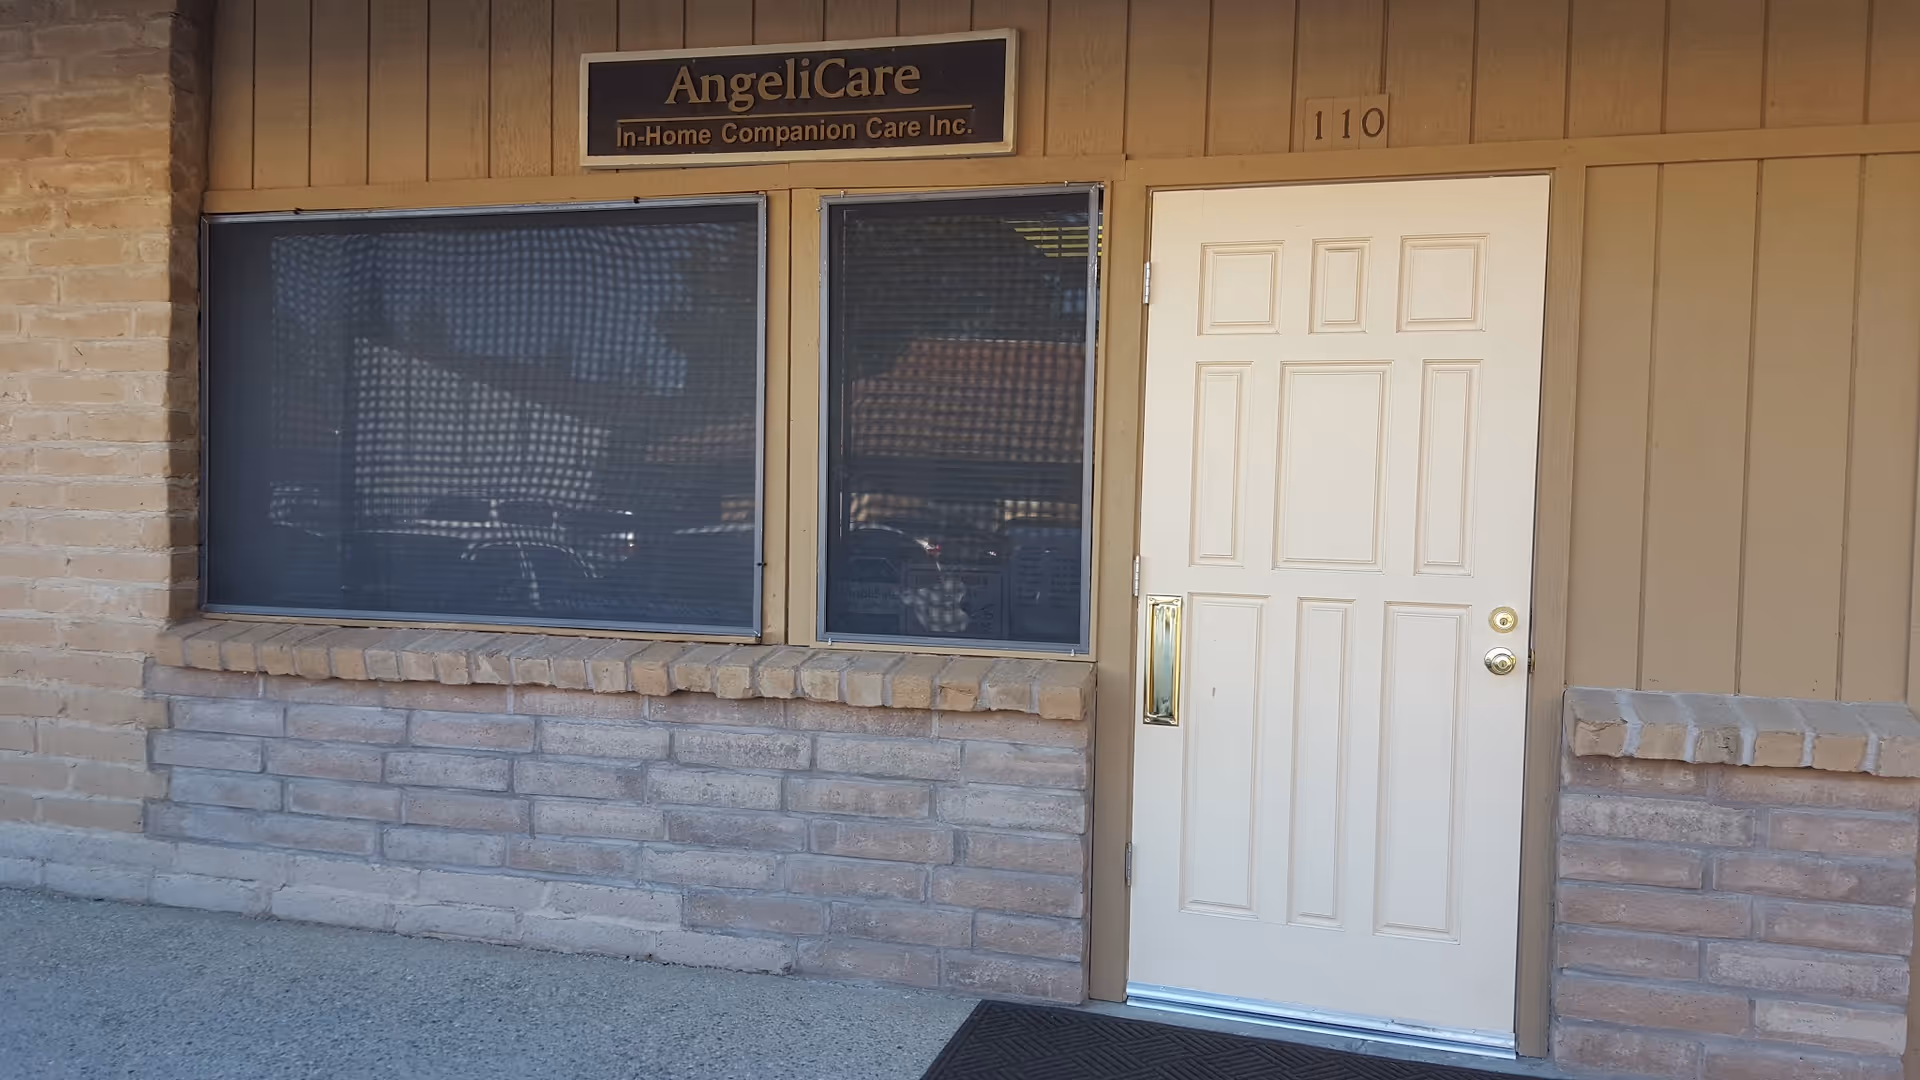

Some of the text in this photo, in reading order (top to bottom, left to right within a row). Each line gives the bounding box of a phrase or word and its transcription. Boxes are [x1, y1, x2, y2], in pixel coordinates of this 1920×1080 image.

[665, 58, 920, 112] AngeliCare
[617, 114, 972, 148] In-Home Companion Care Inc.
[1315, 107, 1385, 140] 110
